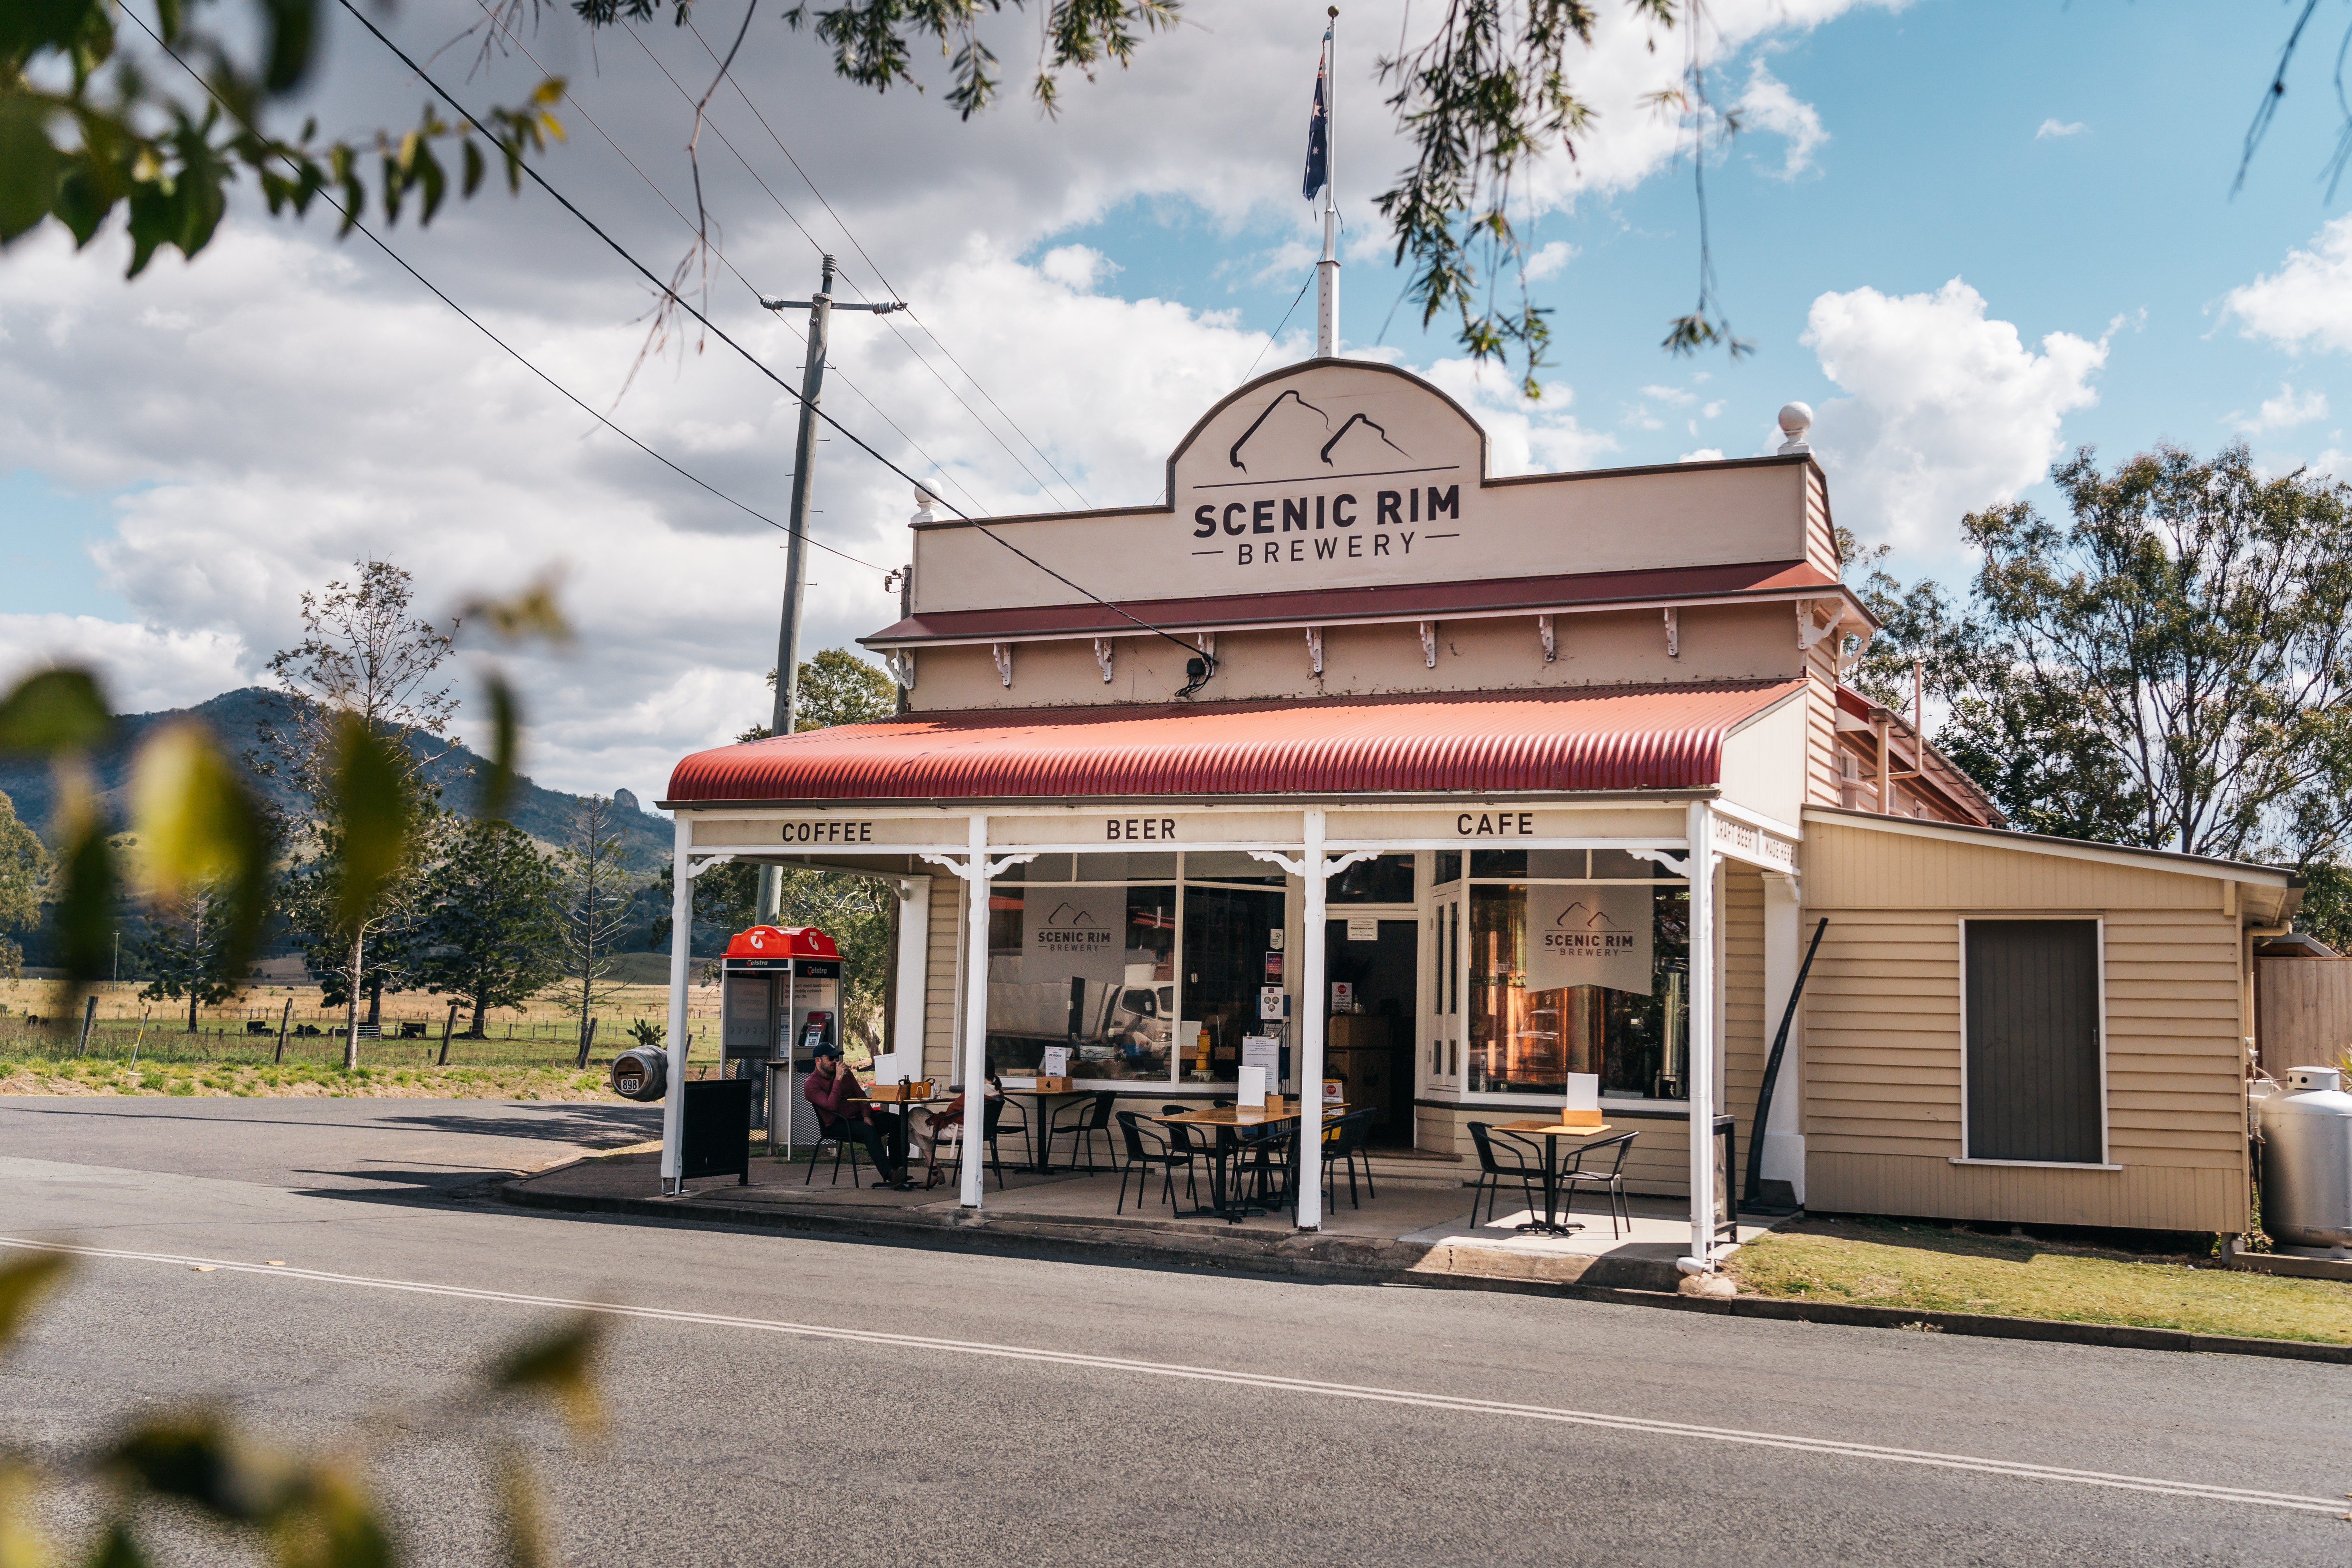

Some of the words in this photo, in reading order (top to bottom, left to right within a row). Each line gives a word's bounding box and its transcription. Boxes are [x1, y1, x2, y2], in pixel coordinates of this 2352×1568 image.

[1193, 493, 1357, 538] SCENIC
[1377, 484, 1460, 525] RIM
[1238, 531, 1415, 565] BREWERY
[782, 822, 872, 841] COFFEE
[1107, 819, 1175, 840] BEER
[1458, 813, 1533, 835] CAFE
[1716, 819, 1735, 843] CRAFT
[1737, 826, 1752, 849] BEER
[1765, 838, 1779, 859] MADE
[1780, 843, 1793, 863] HERE
[1038, 932, 1083, 942] SCENIC
[1088, 932, 1110, 942] RIM
[1545, 934, 1600, 946] SCENIC
[1606, 936, 1633, 947] RIM
[1560, 948, 1619, 956] BREWERY
[807, 966, 827, 976] Telstra
[623, 1079, 637, 1090] 898
